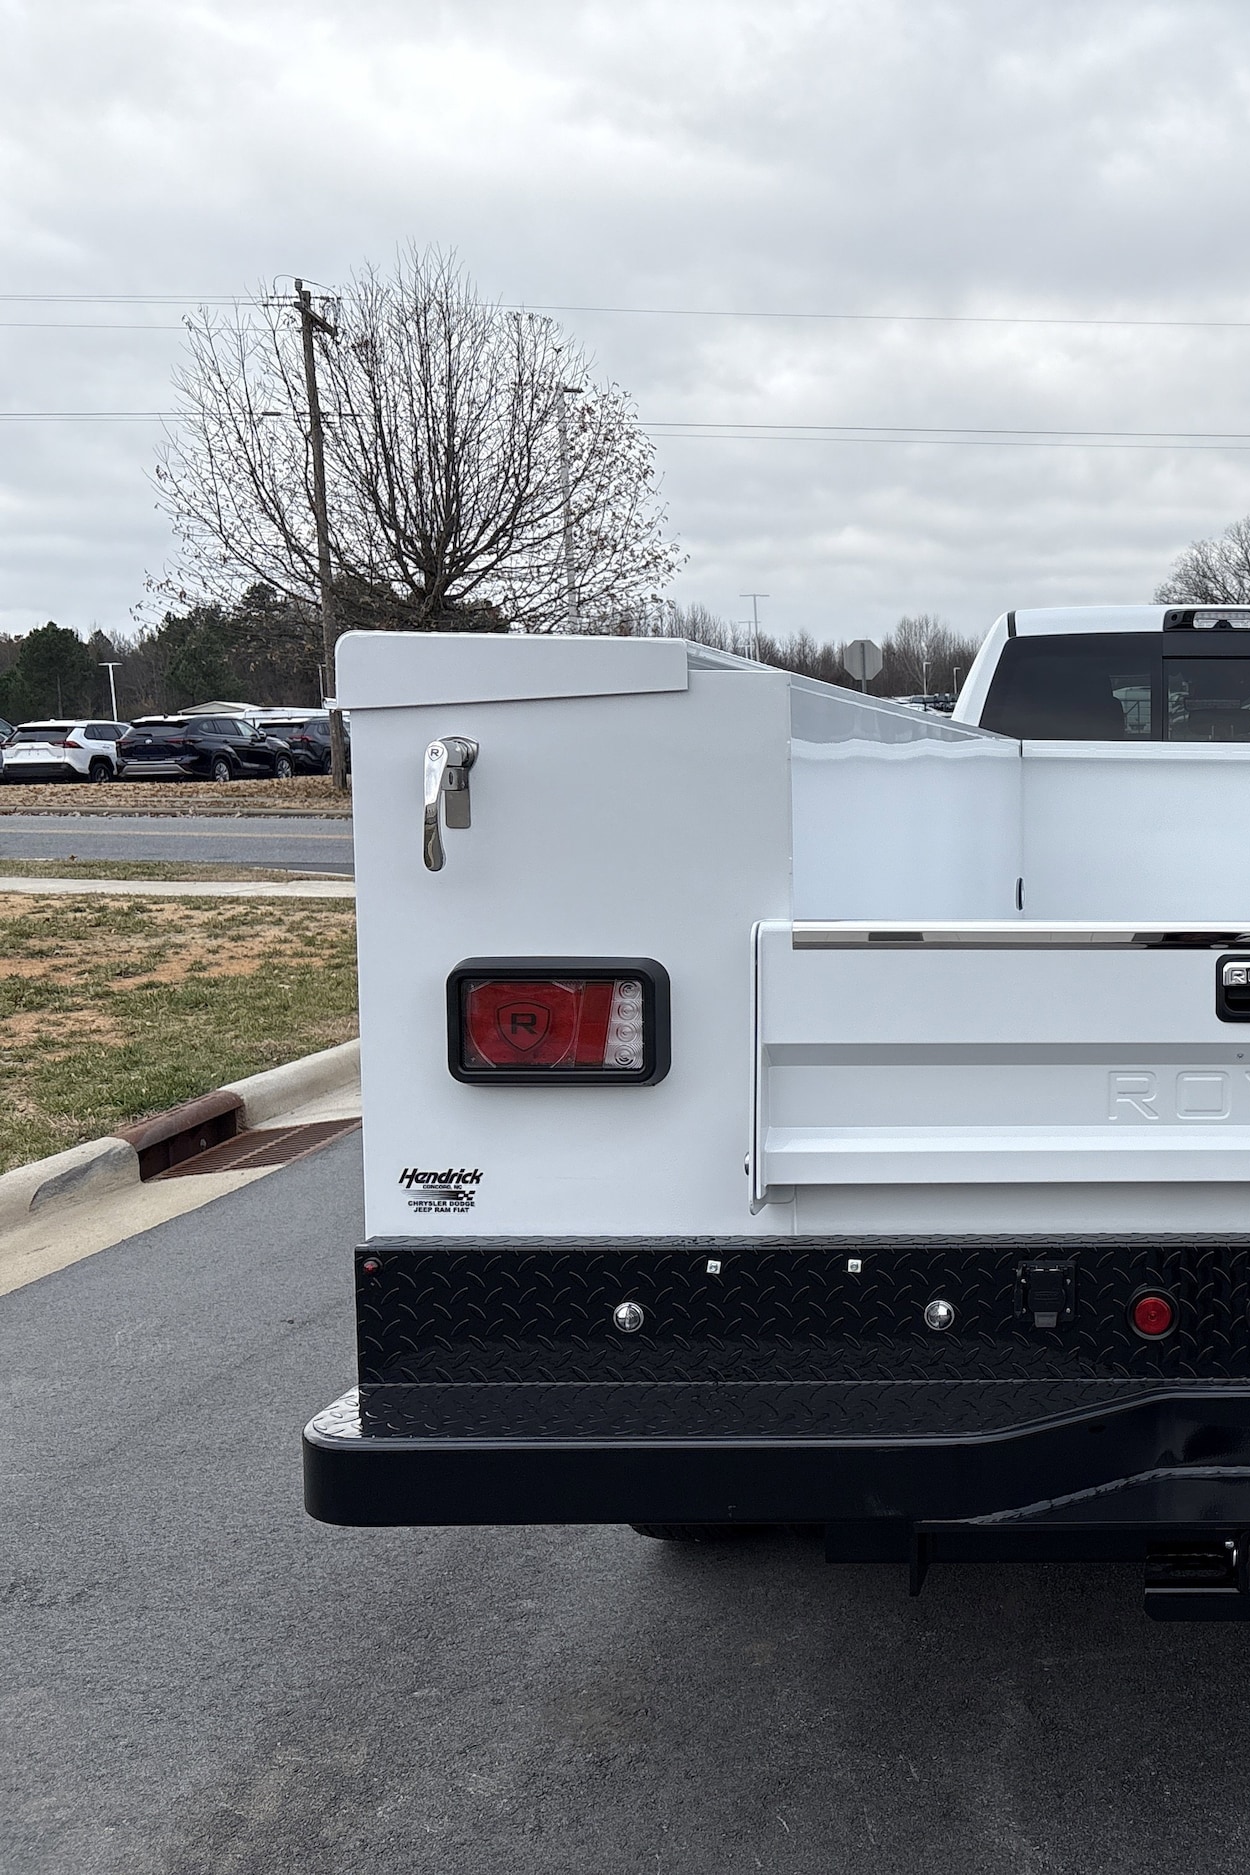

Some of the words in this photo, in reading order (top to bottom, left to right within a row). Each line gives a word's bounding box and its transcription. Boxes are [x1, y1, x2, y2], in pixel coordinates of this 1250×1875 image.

[430, 748, 440, 757] R
[510, 1012, 538, 1035] R
[398, 1168, 484, 1189] Hendrick
